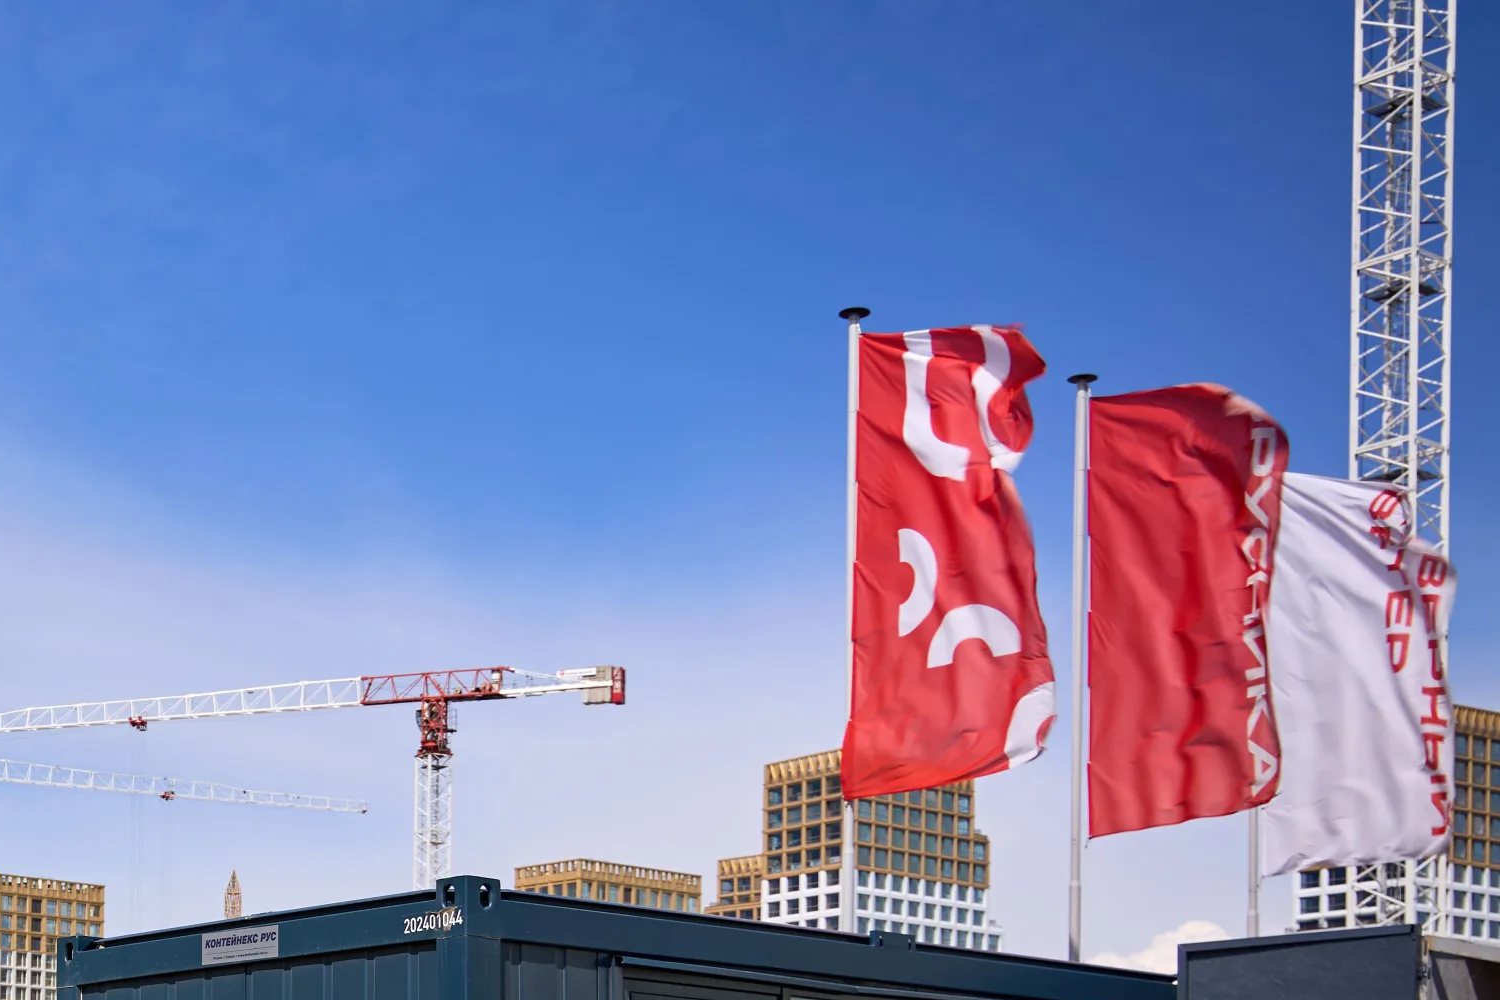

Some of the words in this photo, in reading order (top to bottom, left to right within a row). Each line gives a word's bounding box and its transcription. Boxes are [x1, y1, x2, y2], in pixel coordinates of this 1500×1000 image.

[1241, 414, 1280, 798] РУСНИКА
[1416, 552, 1453, 838] ВЕРНЫЙ
[205, 933, 259, 949] КОНТЕЙНЕКС
[260, 931, 277, 943] РУС
[403, 909, 464, 935] 202401044
